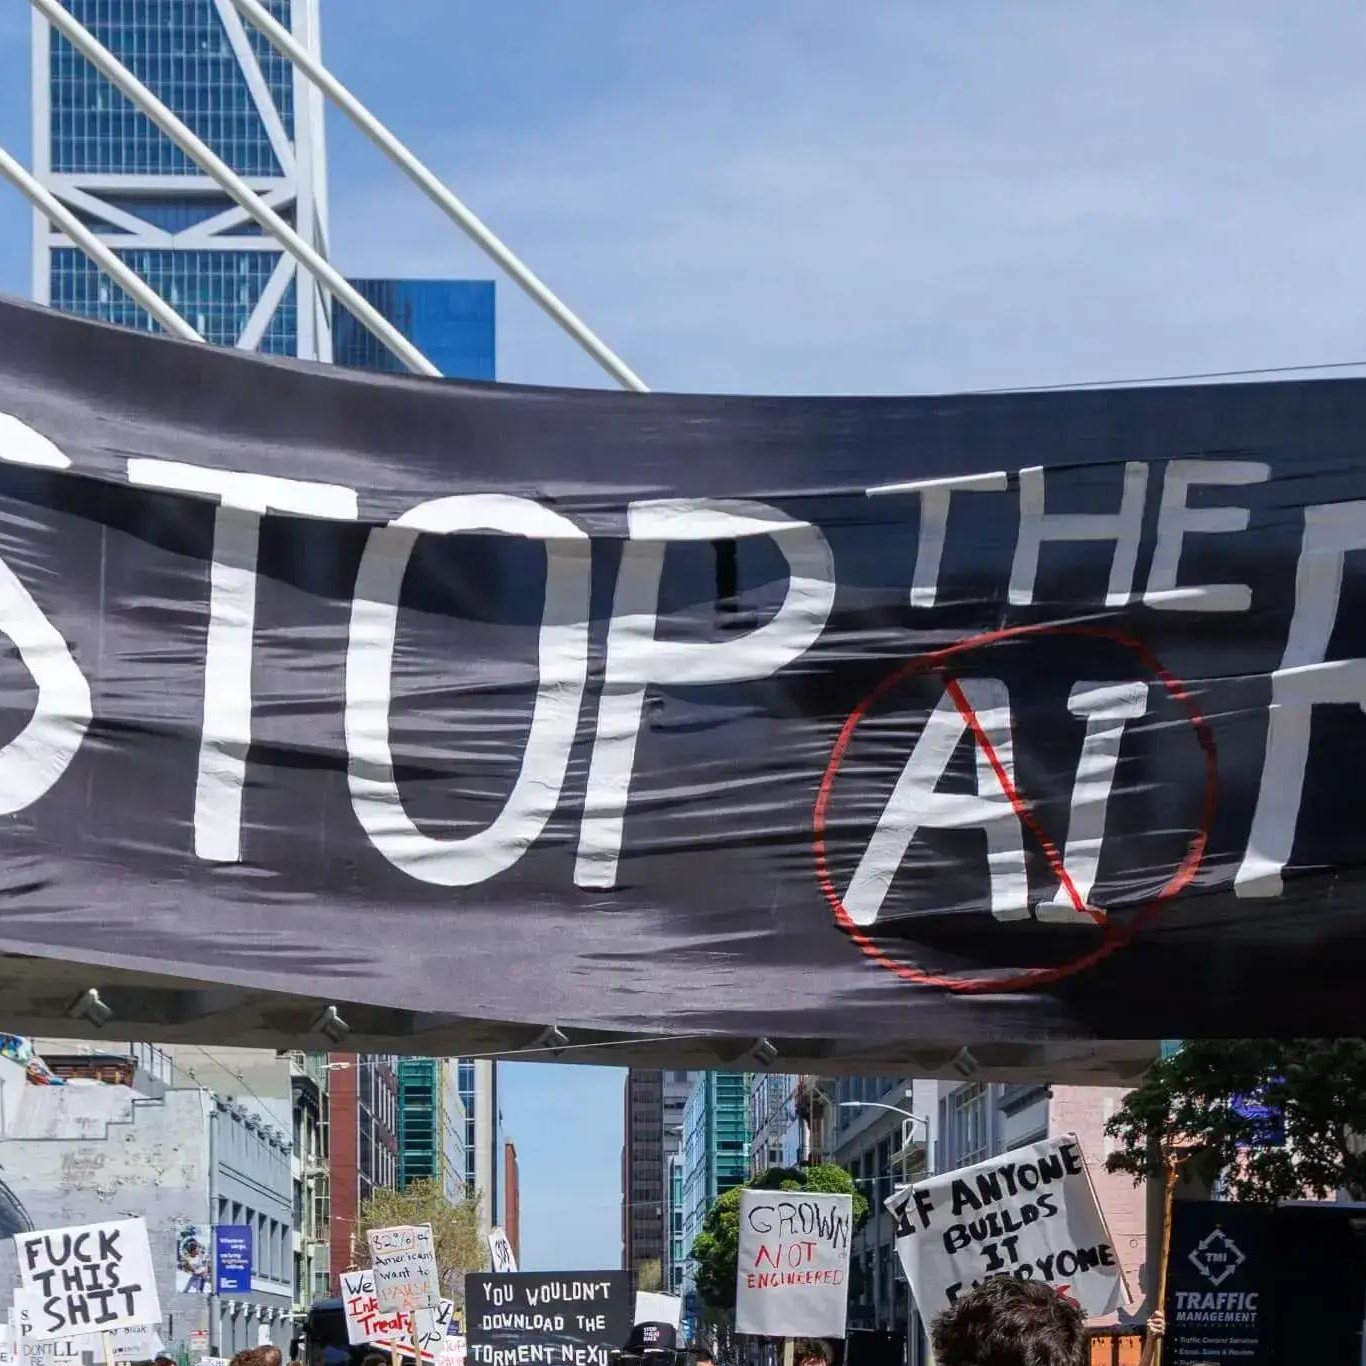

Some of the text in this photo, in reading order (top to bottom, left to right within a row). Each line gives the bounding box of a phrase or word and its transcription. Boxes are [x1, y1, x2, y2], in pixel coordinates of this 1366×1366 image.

[865, 459, 1272, 611] THE
[839, 677, 1150, 926] AI
[893, 1143, 1082, 1238] IF ANYONE
[748, 1203, 849, 1248] GROWN
[943, 1194, 1058, 1254] BUILDS
[24, 1229, 123, 1270] FUCK
[372, 1232, 412, 1250] 82%
[980, 1235, 1019, 1272] IT
[375, 1252, 434, 1266] Americans
[755, 1241, 817, 1268] NOT
[1205, 1252, 1227, 1263] TMI
[33, 1262, 121, 1298] THIS
[344, 1275, 373, 1295] We
[747, 1269, 844, 1289] ENGINEERED
[483, 1282, 611, 1306] YOU WOULDN'T
[1175, 1292, 1259, 1310] TRAFFIC
[43, 1284, 142, 1333] SHIT
[1176, 1312, 1258, 1322] MANAGEMENT
[357, 1312, 414, 1336] Treaty
[483, 1313, 606, 1332] DOWNLOAD THE
